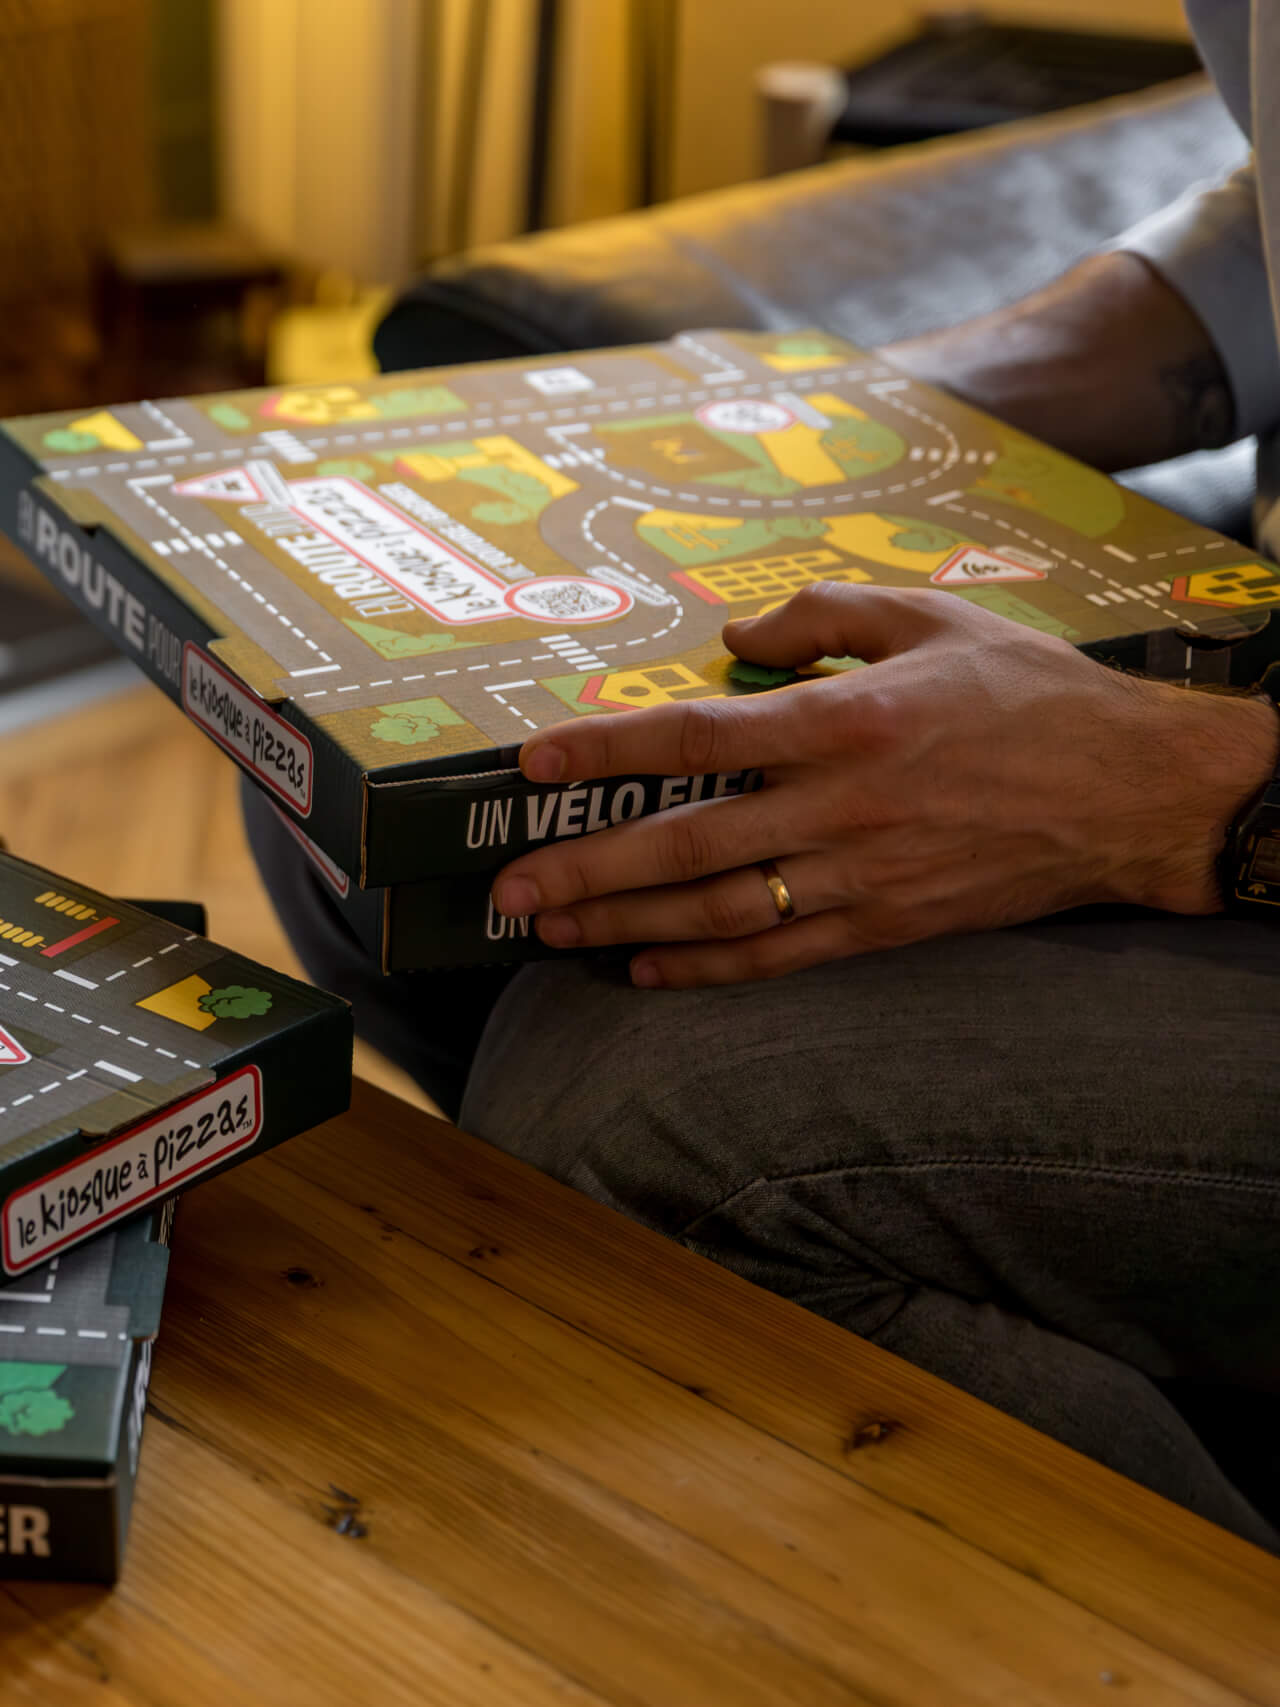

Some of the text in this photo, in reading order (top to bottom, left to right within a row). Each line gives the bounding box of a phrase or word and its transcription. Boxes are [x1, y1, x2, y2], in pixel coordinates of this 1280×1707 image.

[276, 532, 394, 599] ROUTE
[36, 511, 146, 651] ROUTE
[200, 663, 243, 737] kiosque
[253, 718, 305, 789] pizzas
[466, 797, 512, 849] UN
[526, 780, 646, 841] VÉLO
[17, 1216, 38, 1249] le
[40, 1160, 133, 1236] kiosque
[136, 1153, 149, 1181] à
[153, 1094, 248, 1187] pizzas
